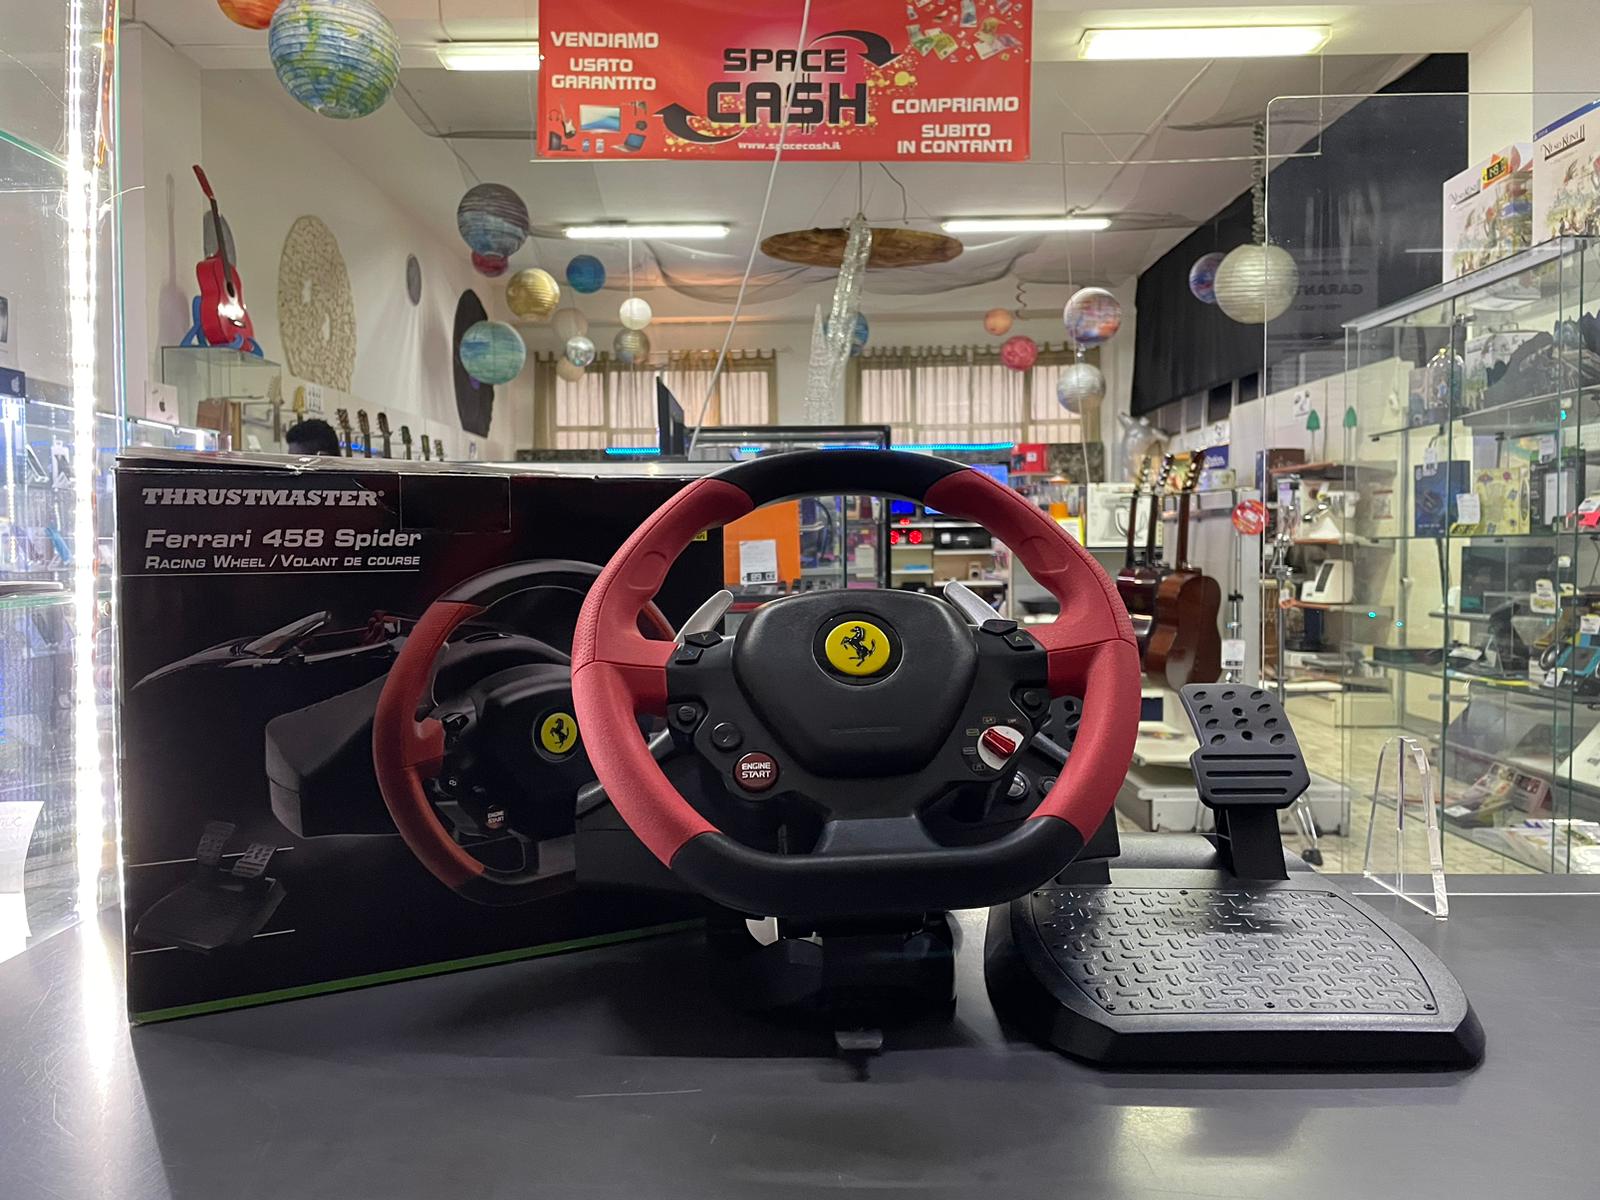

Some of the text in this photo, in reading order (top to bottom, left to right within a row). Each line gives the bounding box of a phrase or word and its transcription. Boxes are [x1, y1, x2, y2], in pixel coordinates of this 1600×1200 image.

[550, 30, 660, 49] VENDIAMO
[569, 57, 634, 73] USATO
[722, 47, 848, 73] SPACE
[551, 74, 657, 91] GARANTITO
[891, 96, 1020, 114] COMPRIAMO
[921, 123, 991, 138] SUBITO
[737, 140, 842, 152] www.spacecash.it
[897, 139, 1013, 154] IN CONTANTI
[145, 528, 422, 551] Ferrari 458 Spider
[367, 556, 421, 566] COURSE
[741, 762, 771, 770] ENGINE
[741, 770, 771, 779] START
